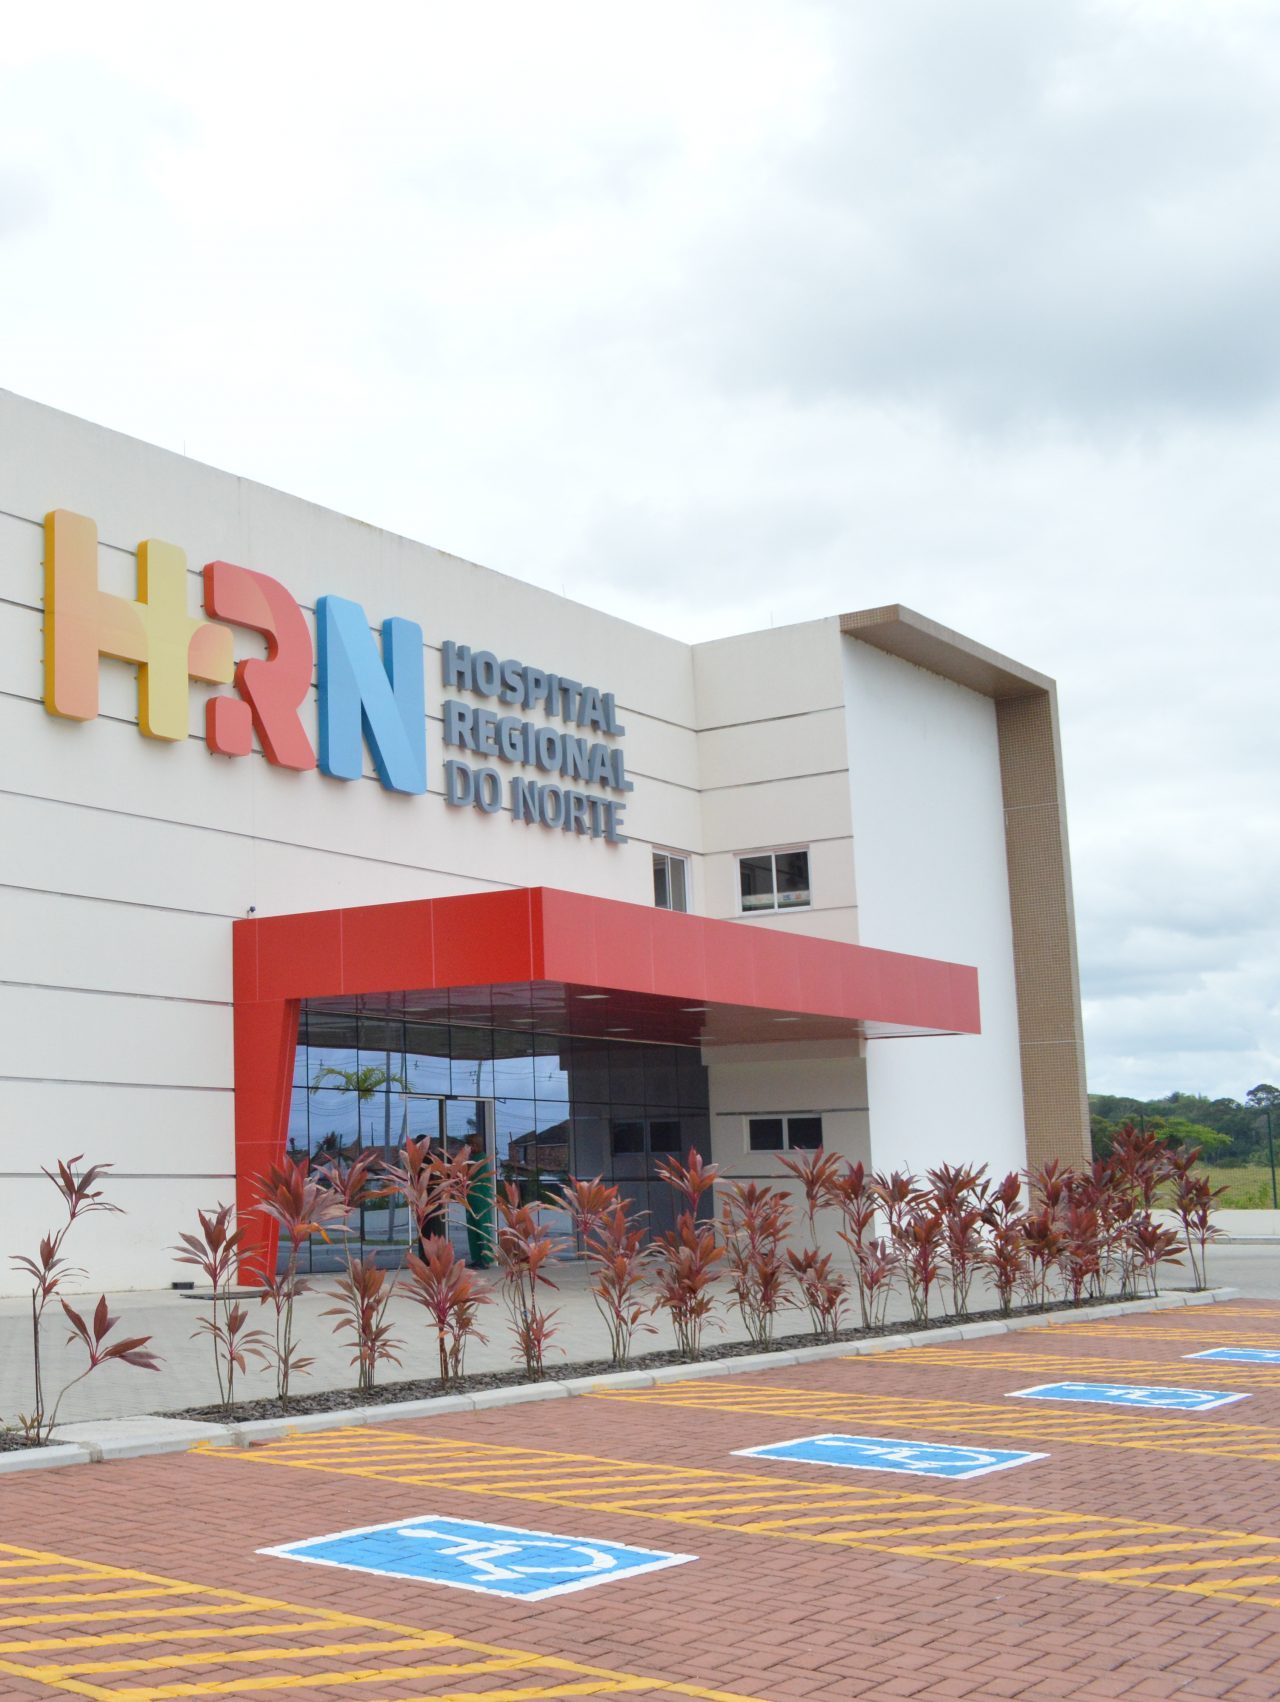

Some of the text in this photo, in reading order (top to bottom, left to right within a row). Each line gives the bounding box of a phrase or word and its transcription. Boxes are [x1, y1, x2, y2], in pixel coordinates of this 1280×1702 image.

[44, 508, 427, 796] HRN
[442, 640, 625, 737] HOSPITAL
[444, 700, 634, 793] REGIONAL
[446, 759, 628, 845] DO NORTE
